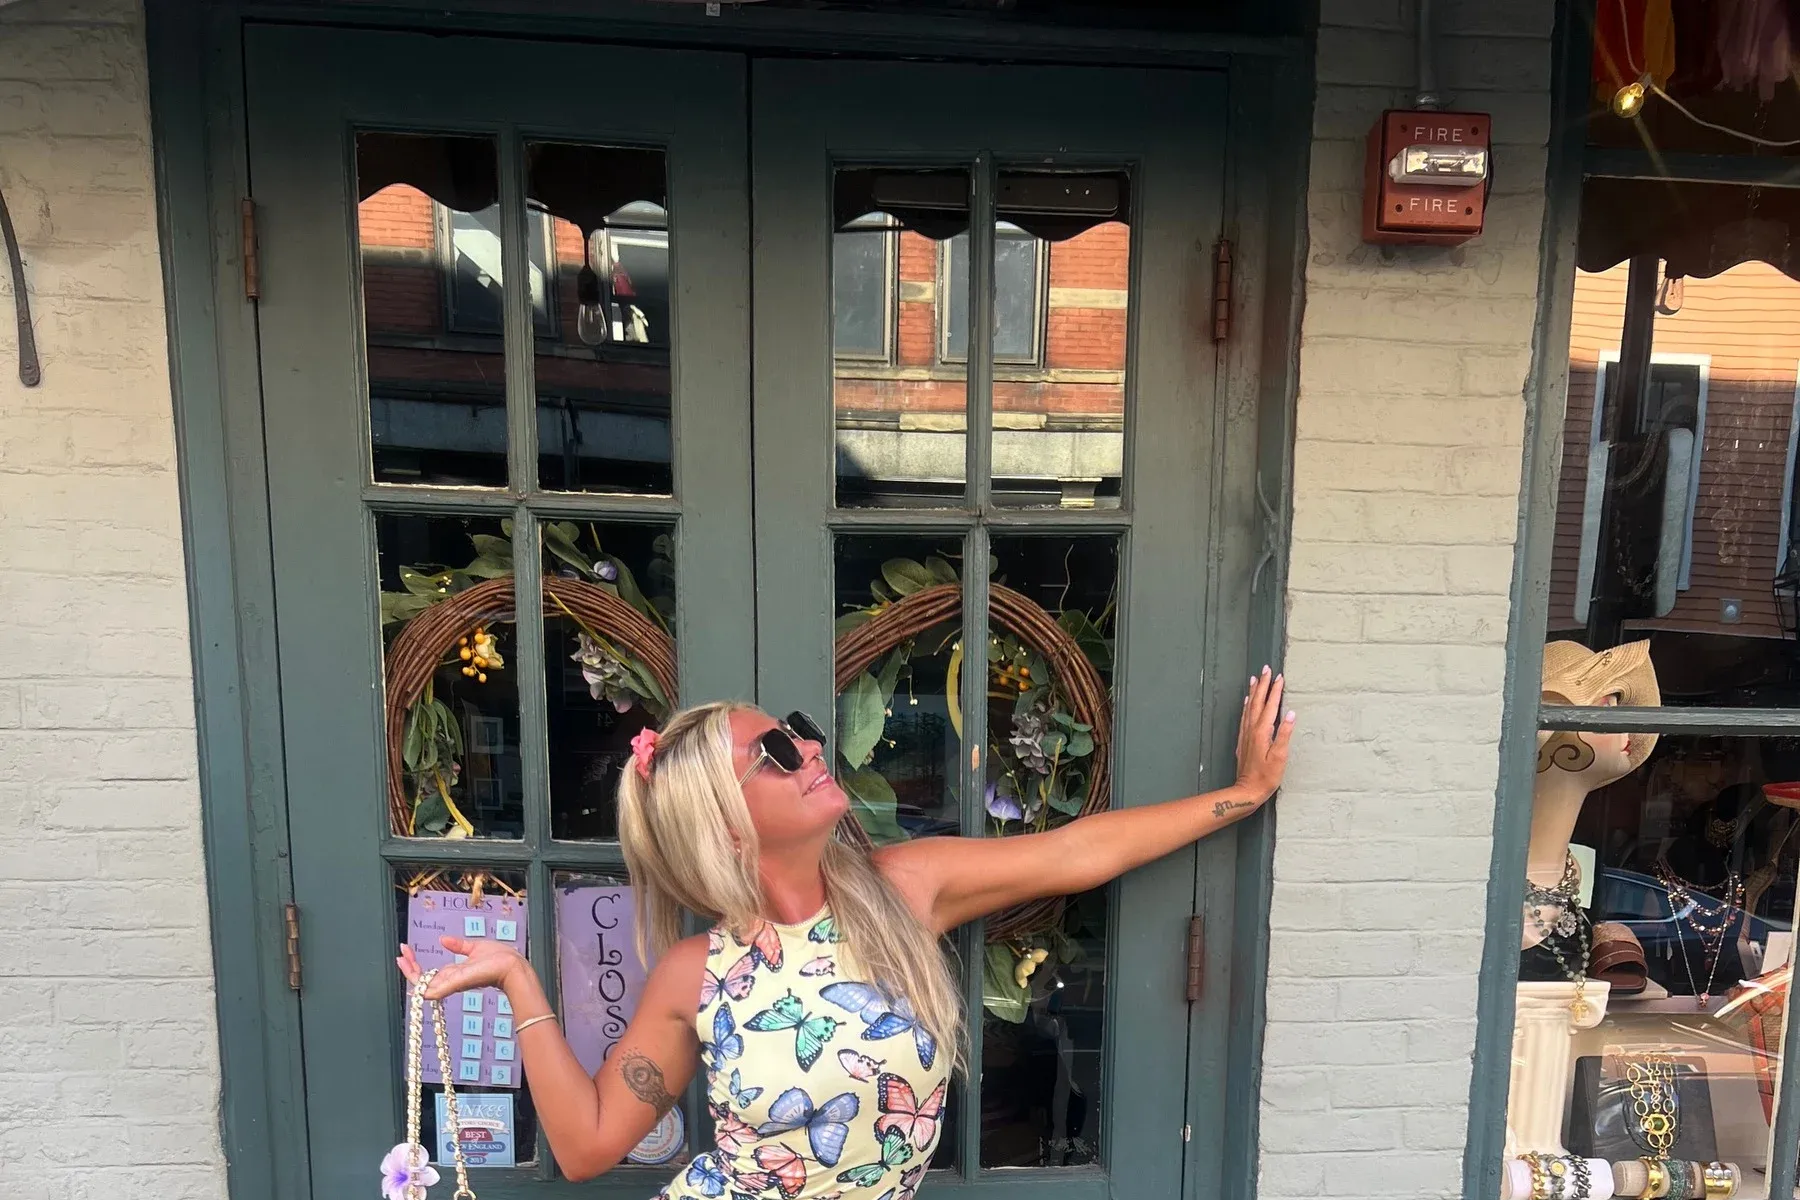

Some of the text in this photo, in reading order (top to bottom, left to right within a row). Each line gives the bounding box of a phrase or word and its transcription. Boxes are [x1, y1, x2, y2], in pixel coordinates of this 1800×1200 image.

[1414, 126, 1463, 142] FIRE
[1410, 197, 1458, 213] FIRE
[443, 896, 493, 911] HOUS
[413, 920, 446, 931] Monday
[471, 922, 480, 931] 11
[502, 925, 510, 935] 6
[414, 943, 443, 955] Tuesday
[498, 1022, 506, 1032] 6
[501, 1046, 509, 1055] 6
[497, 1070, 505, 1080] 5
[465, 1131, 487, 1139] BEST
[469, 1142, 503, 1150] ENGLAND
